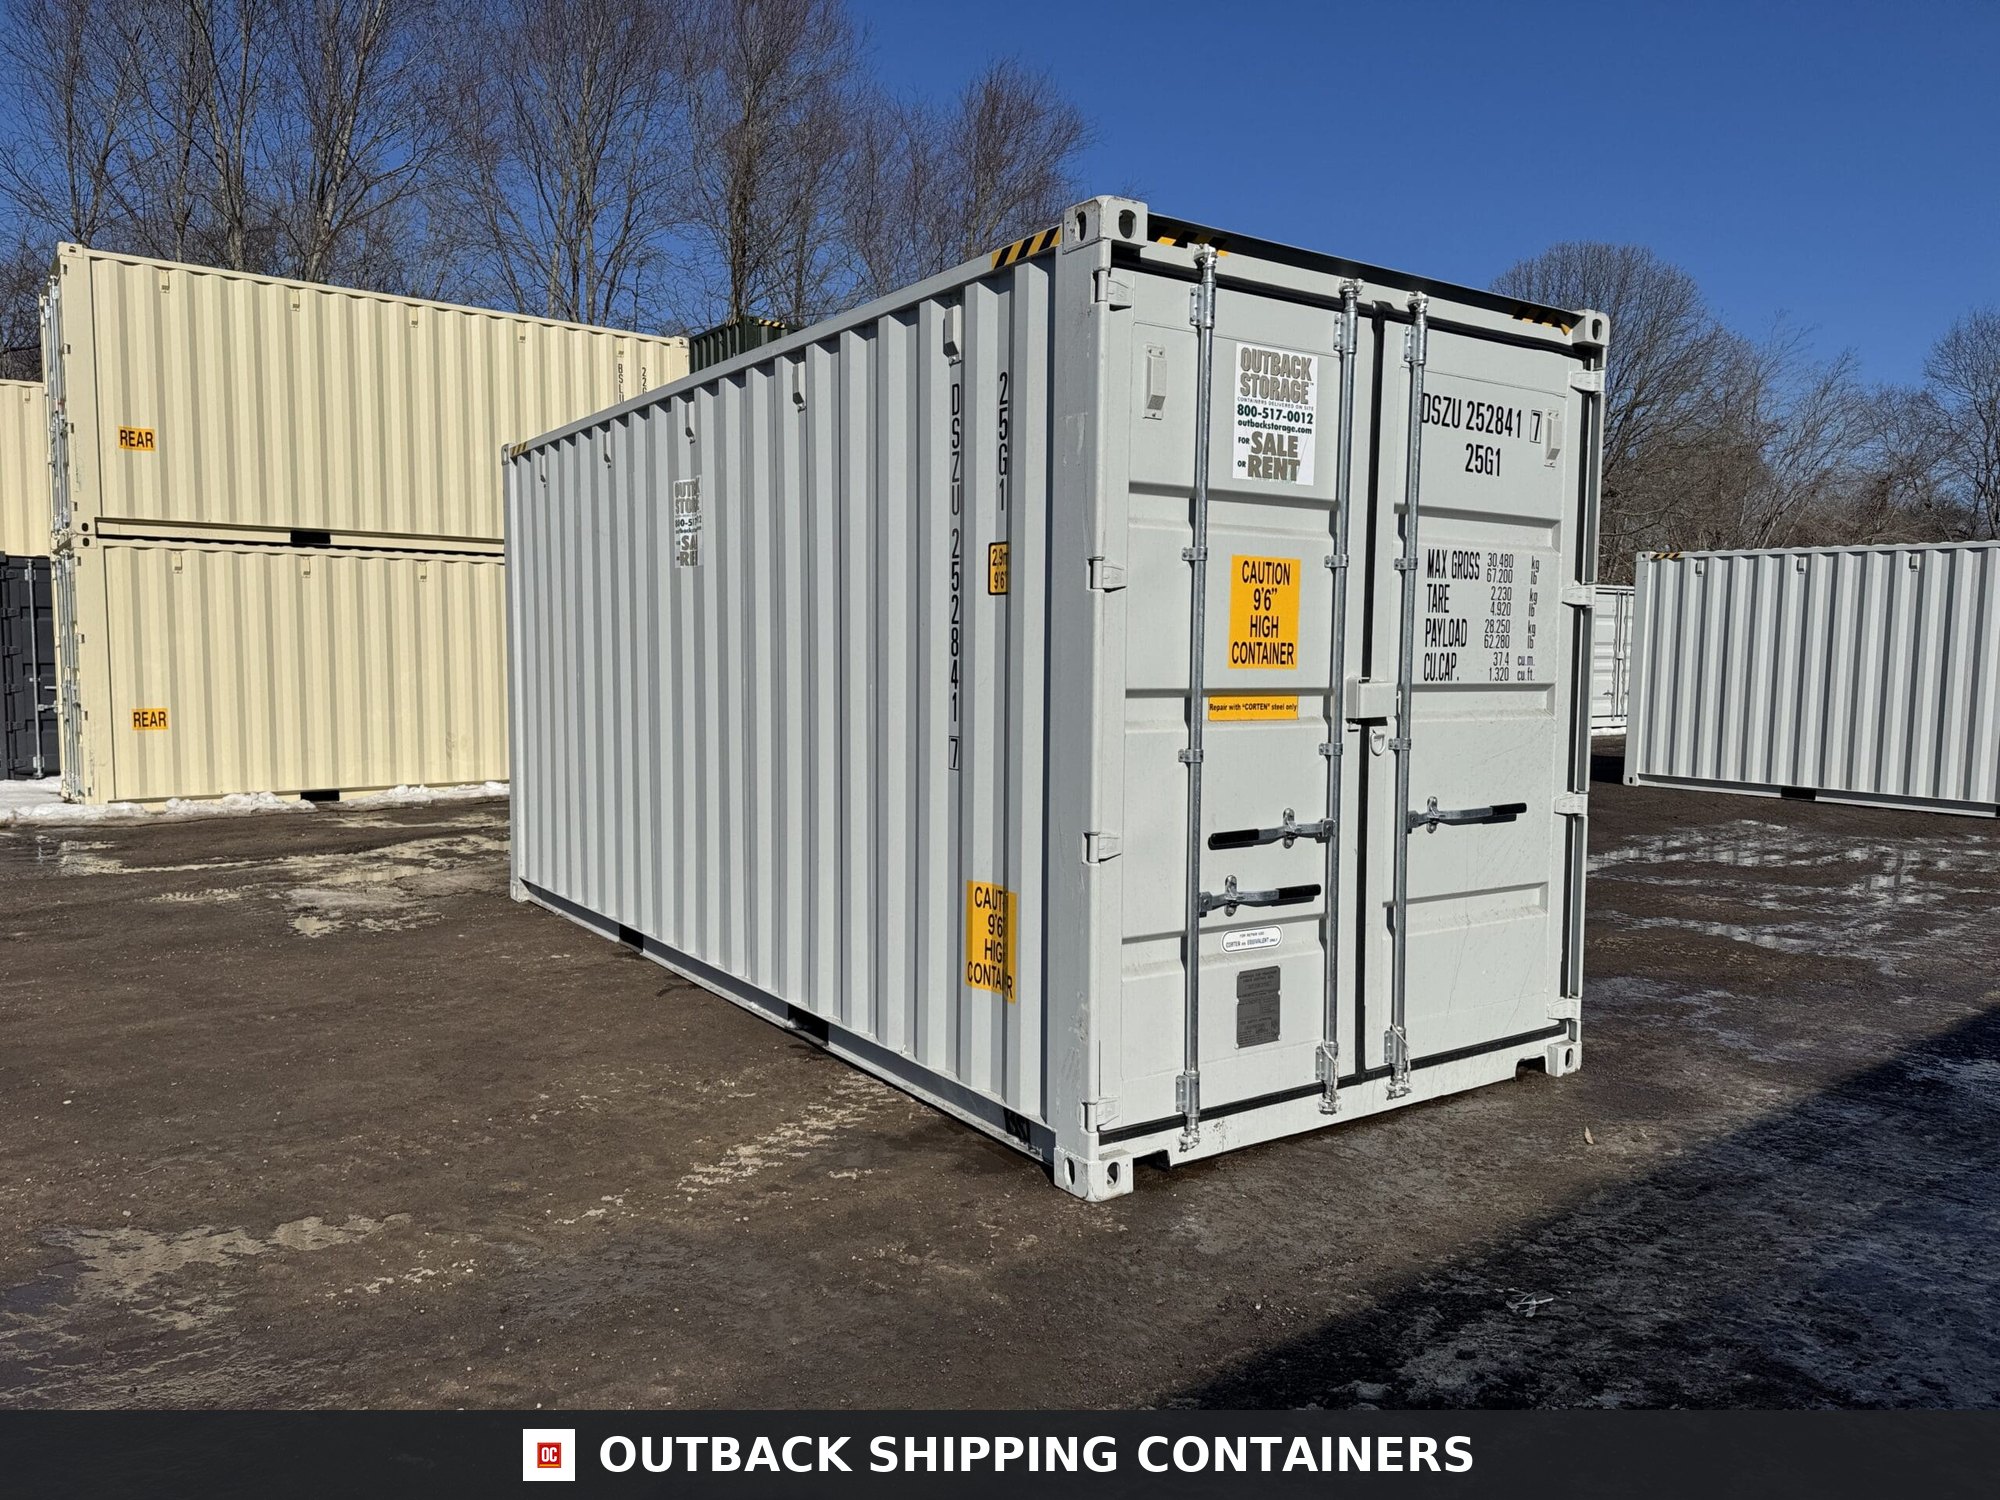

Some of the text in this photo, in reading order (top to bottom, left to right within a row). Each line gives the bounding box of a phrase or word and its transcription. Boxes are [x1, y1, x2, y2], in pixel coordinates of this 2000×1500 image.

[1240, 347, 1312, 381] OUTBACK
[1240, 372, 1309, 405] STORAGE
[1237, 396, 1267, 406] CONTAINERS
[1237, 404, 1314, 424] 800-517-0012
[1422, 393, 1541, 442] DSZU 252841 7
[1238, 418, 1312, 434] outbackstorage.com
[120, 430, 154, 448] REAR
[952, 383, 960, 516] DSZU
[999, 372, 1008, 511] 25G1
[1238, 431, 1298, 458] FOR SALE
[1248, 454, 1300, 482] RENT
[1465, 443, 1501, 477] 25G1
[1242, 560, 1290, 585] CAUTION
[1427, 549, 1480, 580] MAX GROSS
[1487, 553, 1540, 573] 30.480 kg
[1487, 568, 1537, 585] 67.200 lb
[1427, 584, 1450, 613] TARE
[1491, 586, 1538, 605] 2.230 kg
[1490, 602, 1535, 617] 4.920 lb
[951, 528, 960, 722] 252841
[1250, 615, 1279, 638] HIGH
[1425, 618, 1468, 647] PAYLOAD
[1485, 619, 1536, 637] 28.250 kg
[1484, 634, 1534, 649] 62.280 lb
[1232, 642, 1294, 665] CONTAINER
[1493, 652, 1509, 666] 37.4
[1424, 653, 1460, 681] CU.CAP.
[1489, 667, 1509, 681] 1.320
[133, 711, 166, 727] REAR
[1209, 703, 1227, 712] Repair
[1286, 704, 1297, 712] only
